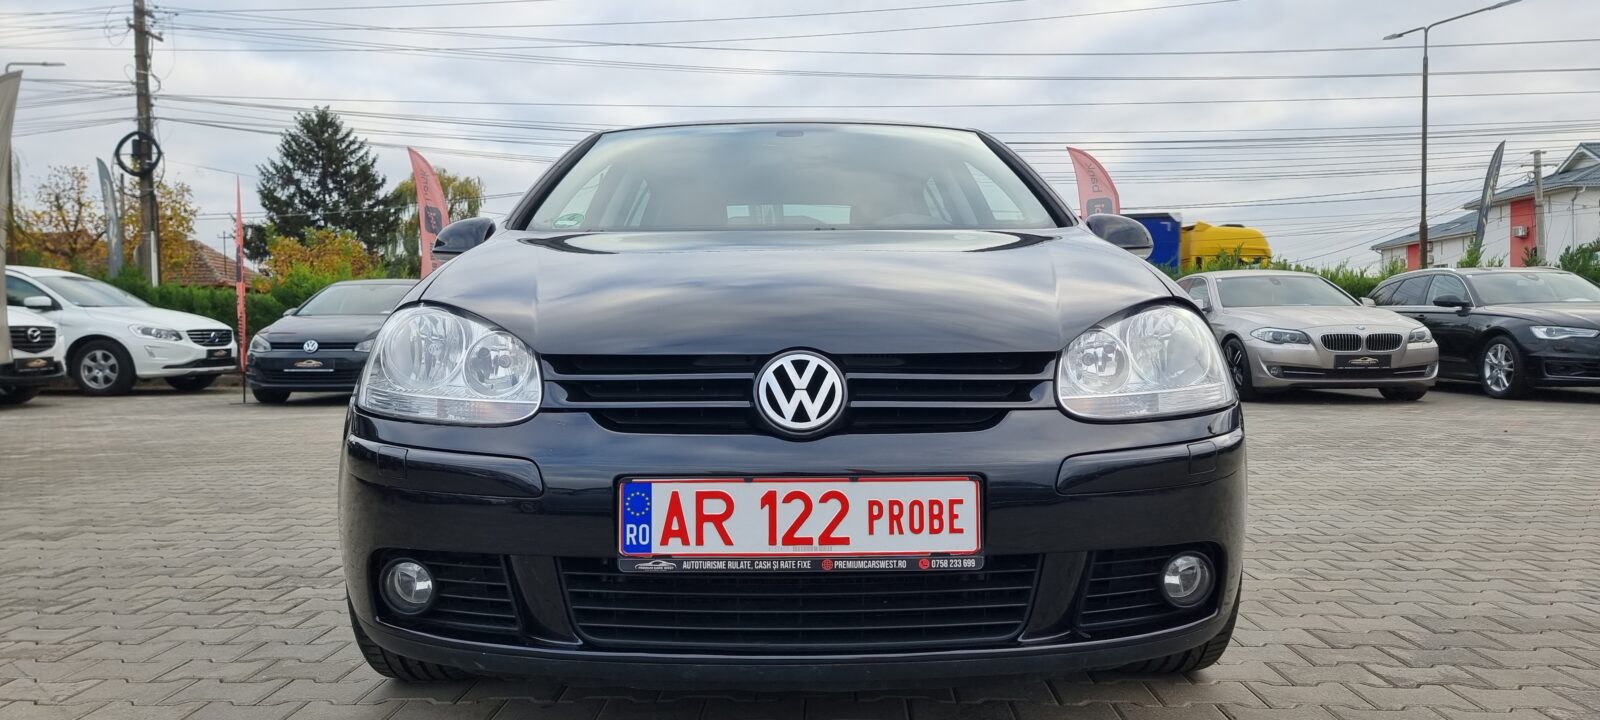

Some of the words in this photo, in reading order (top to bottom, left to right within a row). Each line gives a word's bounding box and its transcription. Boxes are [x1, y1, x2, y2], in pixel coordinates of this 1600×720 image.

[759, 354, 842, 428] VW
[659, 490, 735, 546] AR
[760, 490, 851, 546] 122
[867, 498, 965, 536] PROBE
[626, 523, 650, 546] RO
[682, 560, 726, 569] AUTOTURISME
[727, 560, 753, 570] RULATE,
[754, 560, 771, 569] CASH
[780, 560, 796, 569] RATE
[797, 560, 811, 569] FIXE
[834, 560, 907, 569] PREMIUMCARSWEST.RO
[931, 559, 948, 568] 0758
[949, 559, 962, 568] 233
[963, 558, 976, 568] 699
